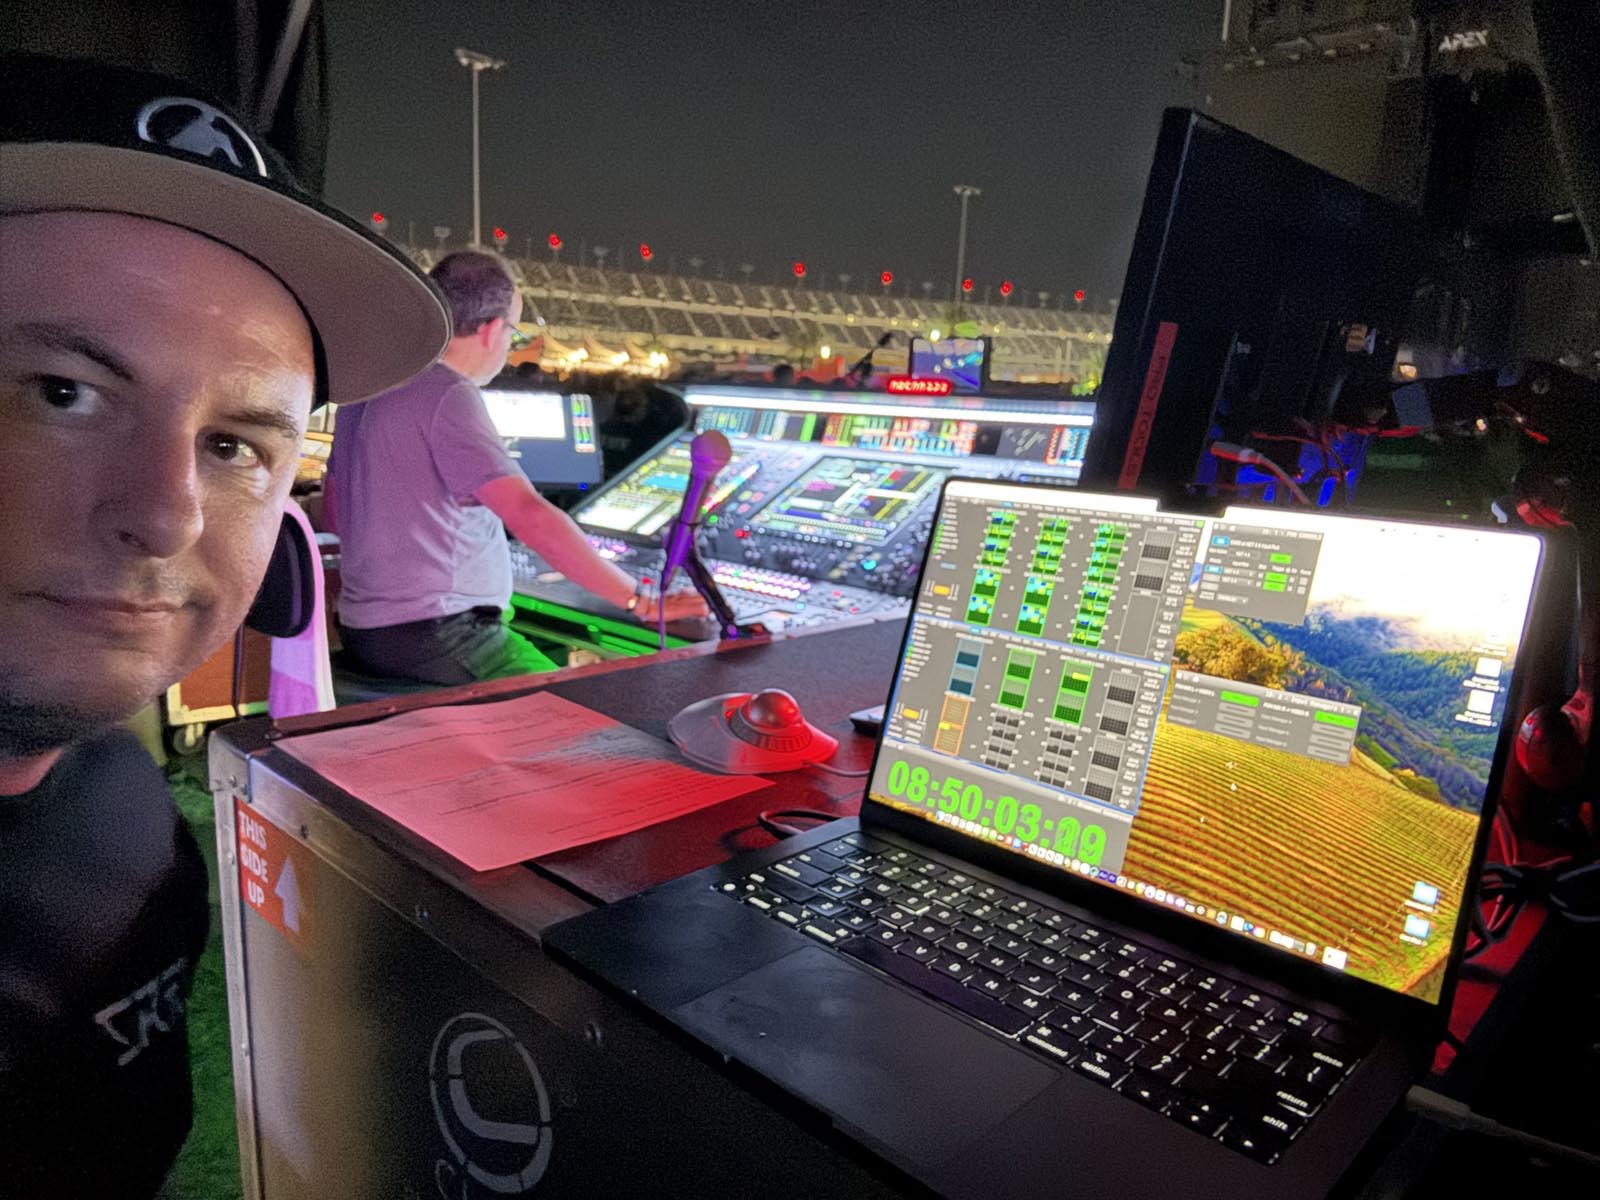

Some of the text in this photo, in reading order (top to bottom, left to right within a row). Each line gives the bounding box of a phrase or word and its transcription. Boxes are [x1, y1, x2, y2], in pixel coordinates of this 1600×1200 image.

[238, 811, 266, 850] THIS
[241, 843, 269, 884] SIDE
[247, 877, 265, 907] UP
[1313, 1052, 1343, 1067] delete
[1081, 1062, 1110, 1078] option
[1277, 1091, 1307, 1107] return
[1263, 1116, 1287, 1130] shift
